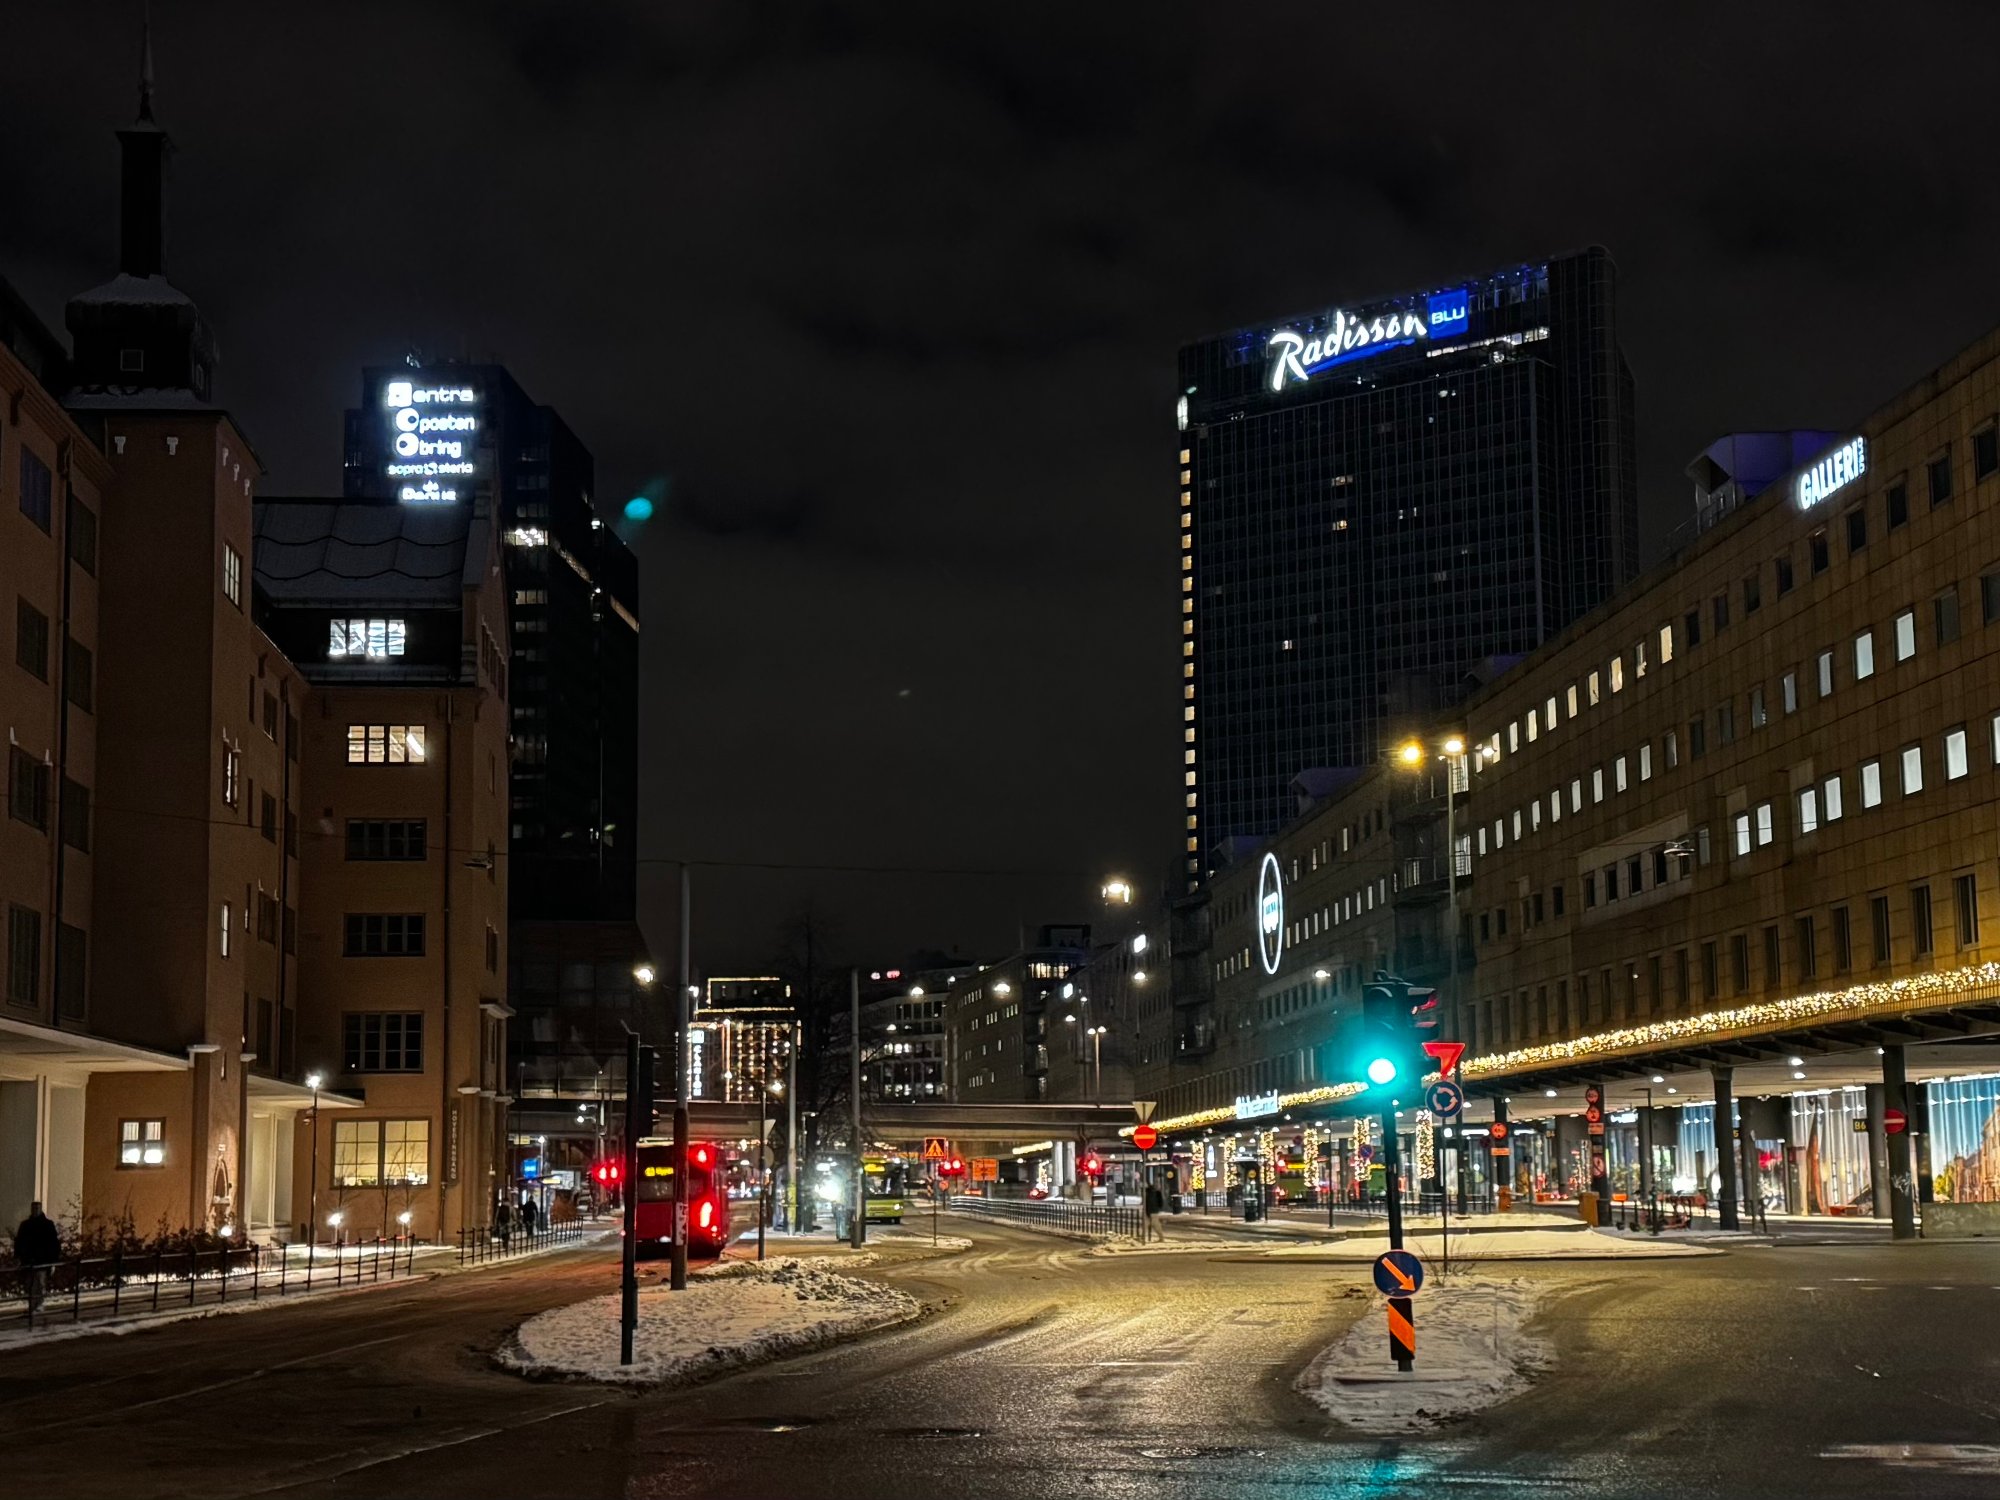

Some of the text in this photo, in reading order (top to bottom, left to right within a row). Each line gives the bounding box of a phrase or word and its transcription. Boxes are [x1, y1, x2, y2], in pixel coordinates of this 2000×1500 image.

[1270, 306, 1465, 391] Radisson BLU
[420, 414, 475, 434] posten
[420, 440, 461, 458] bring
[1800, 441, 1859, 510] GALLERI
